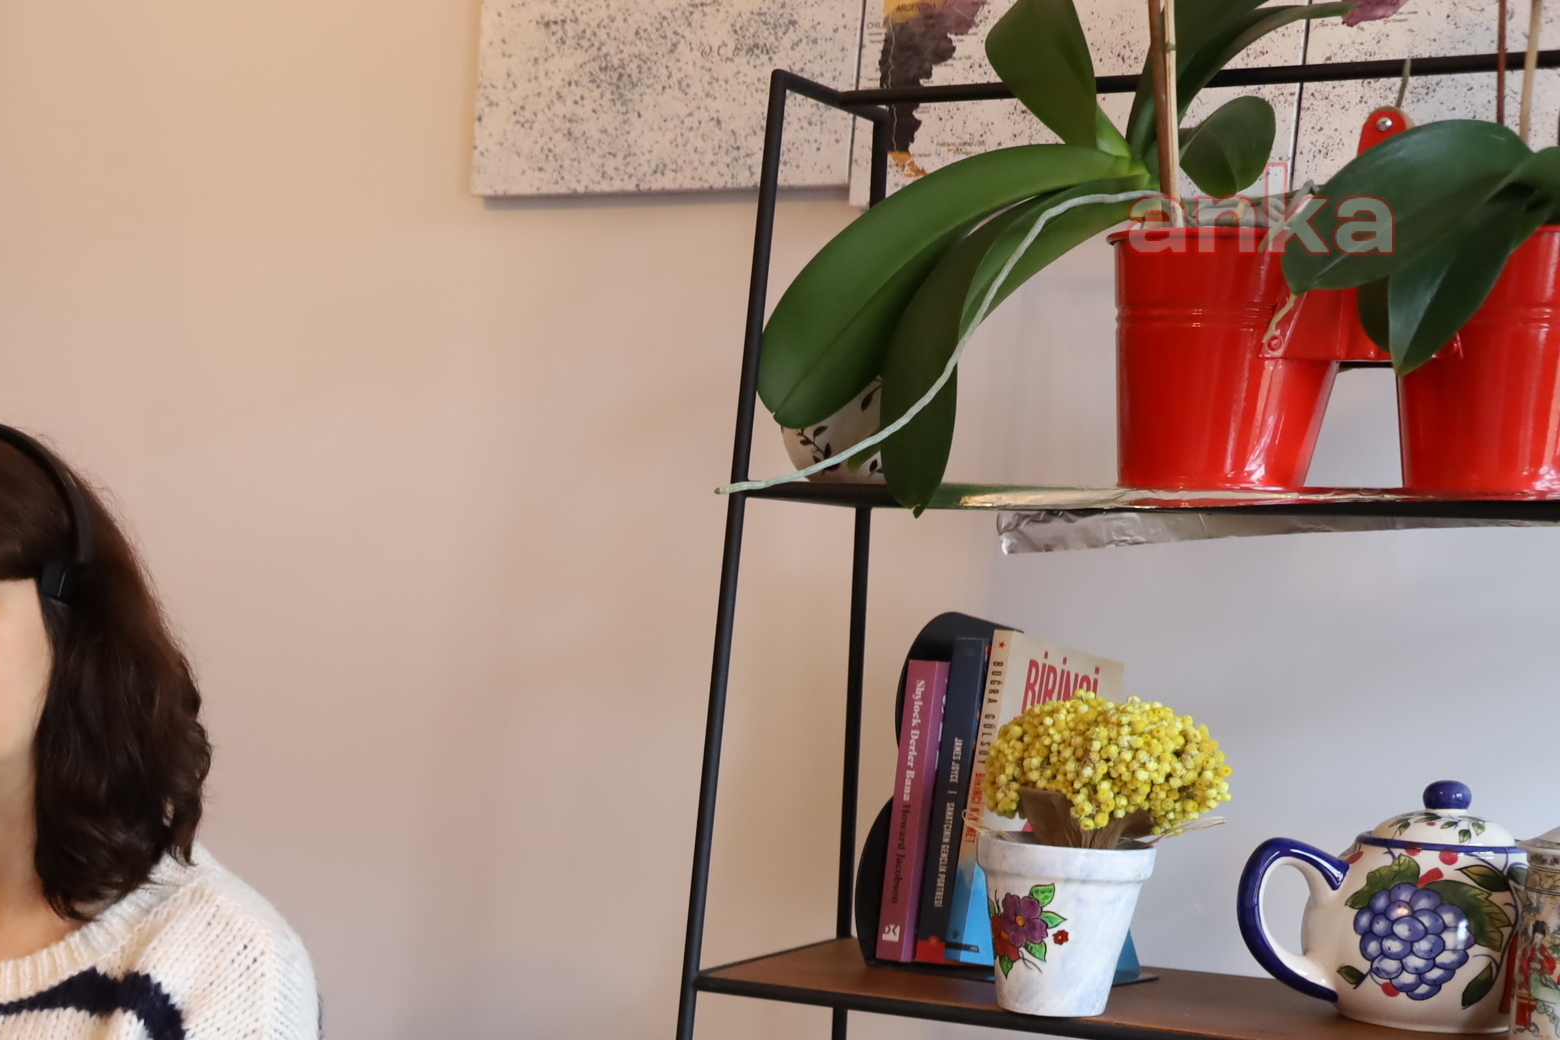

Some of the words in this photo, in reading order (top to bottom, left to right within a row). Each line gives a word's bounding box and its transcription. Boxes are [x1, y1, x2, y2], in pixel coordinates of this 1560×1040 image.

[896, 3, 937, 12] ARGENTINA
[987, 660, 1004, 704] BUĞRA
[911, 679, 926, 728] Shylock
[907, 729, 921, 768] Derler
[952, 737, 964, 760] JAMES
[976, 713, 996, 766] GÜLSOY
[903, 770, 916, 802] Bana
[949, 761, 961, 784] JOYCE
[898, 804, 912, 850] Howard
[942, 802, 956, 845] SANATÇININ
[891, 852, 907, 905] Jacobson
[938, 845, 951, 875] GENÇLİK
